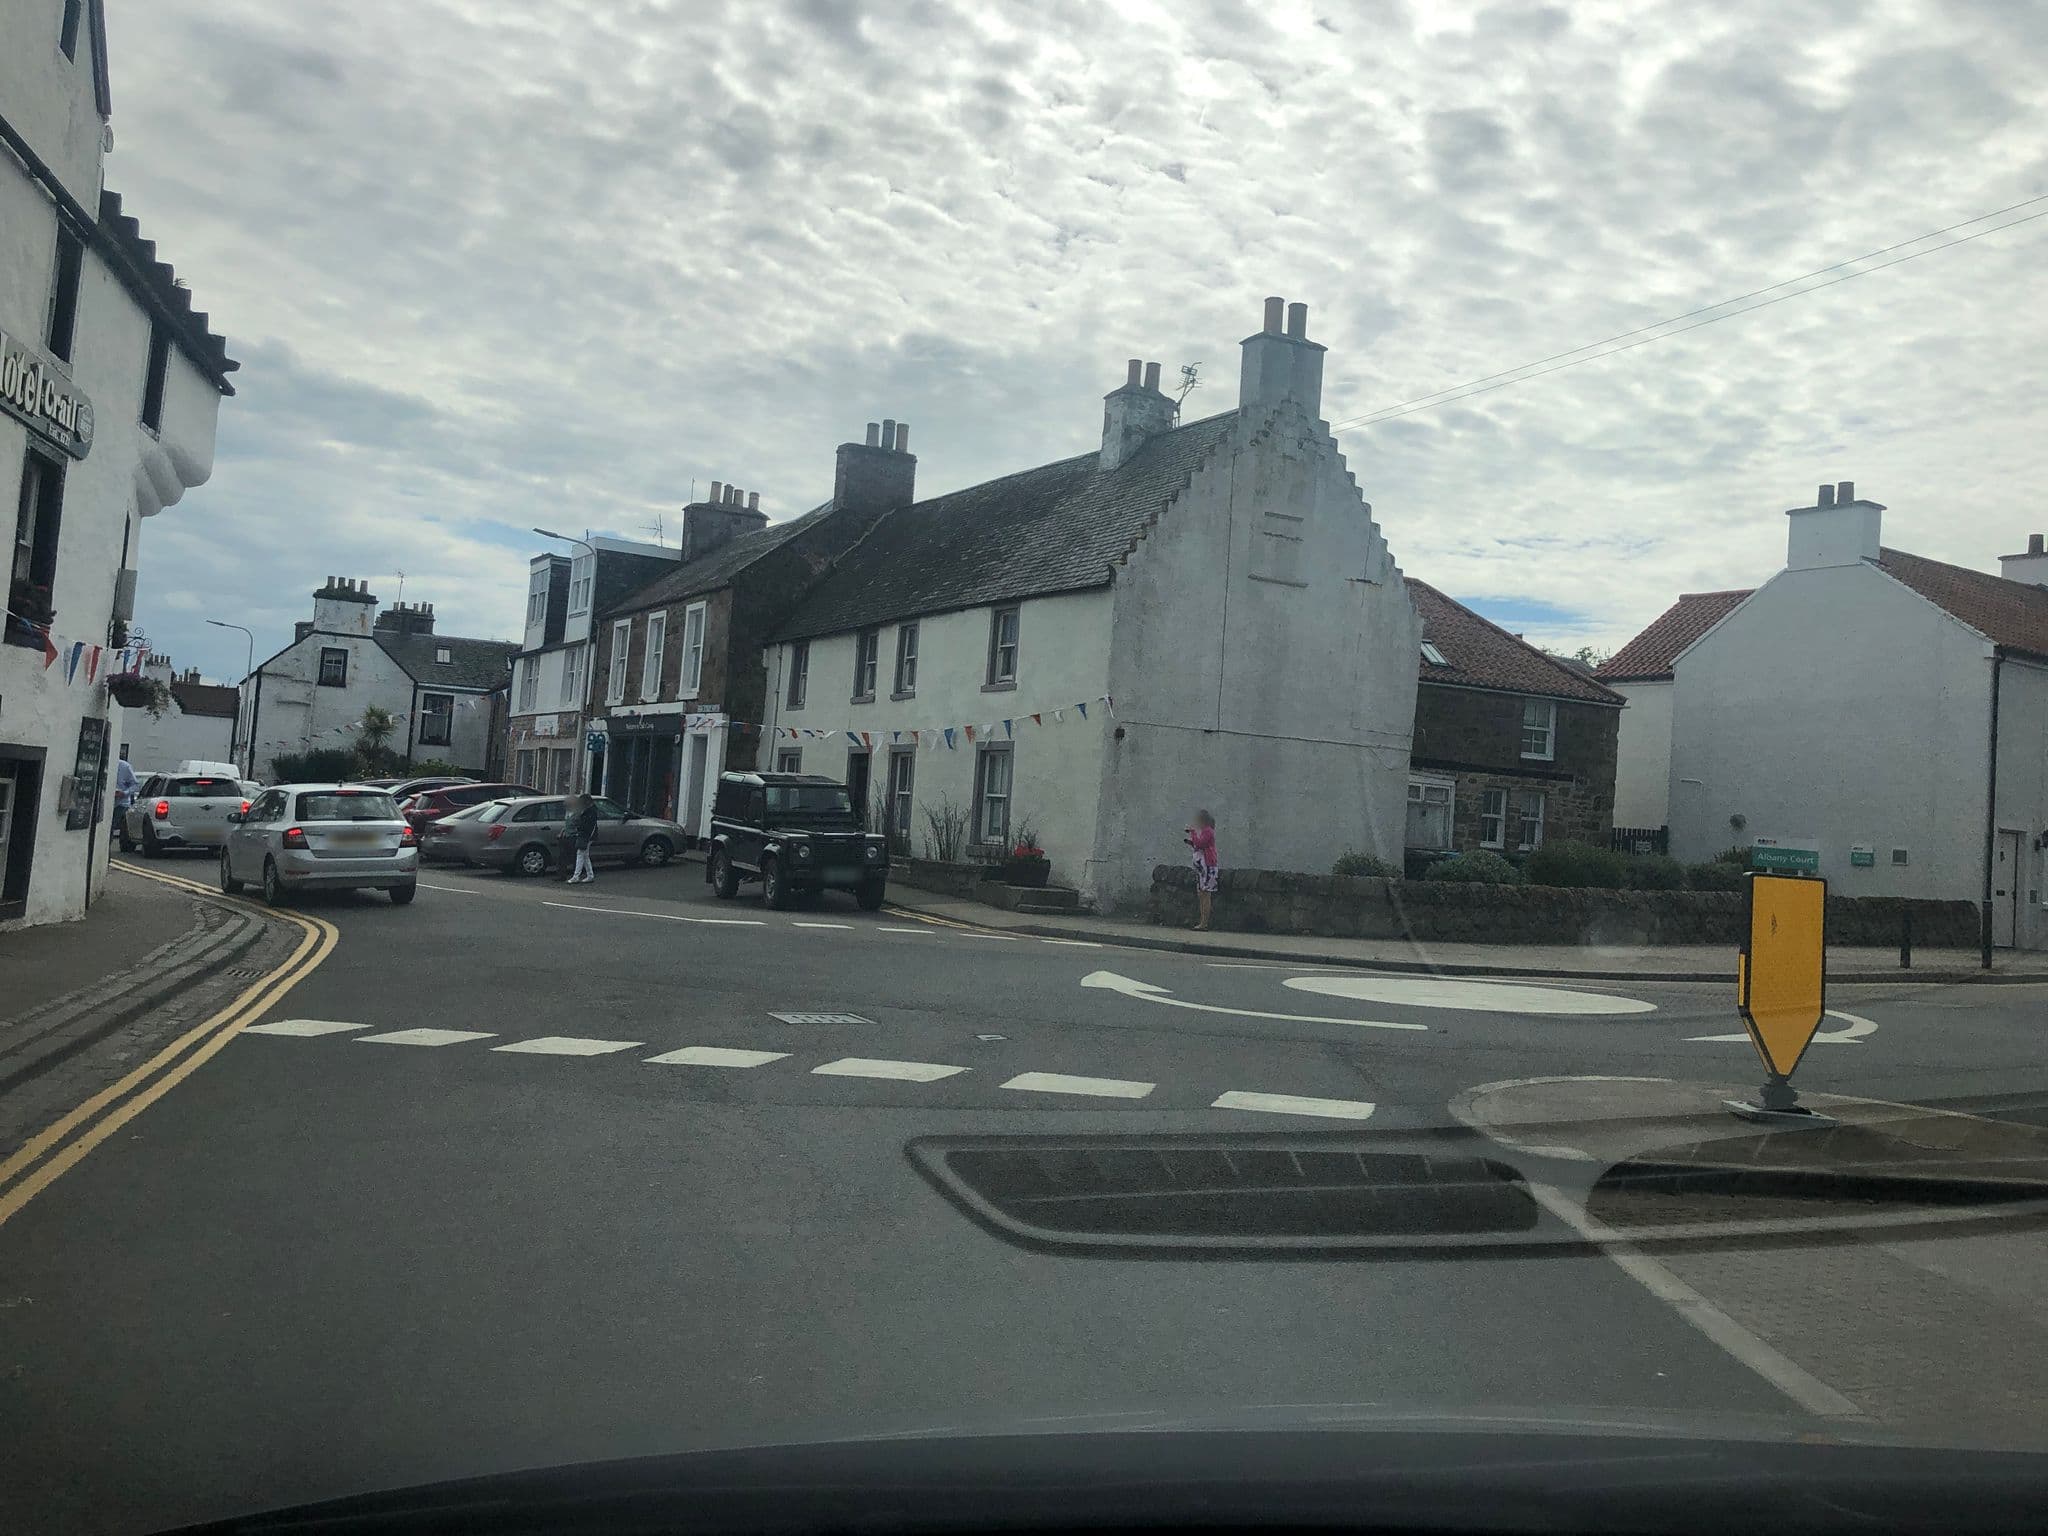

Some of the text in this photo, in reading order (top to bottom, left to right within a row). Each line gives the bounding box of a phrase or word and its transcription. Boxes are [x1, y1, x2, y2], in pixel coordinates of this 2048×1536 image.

[45, 380, 77, 433] Crail
[1757, 852, 1814, 864] Albany Court
